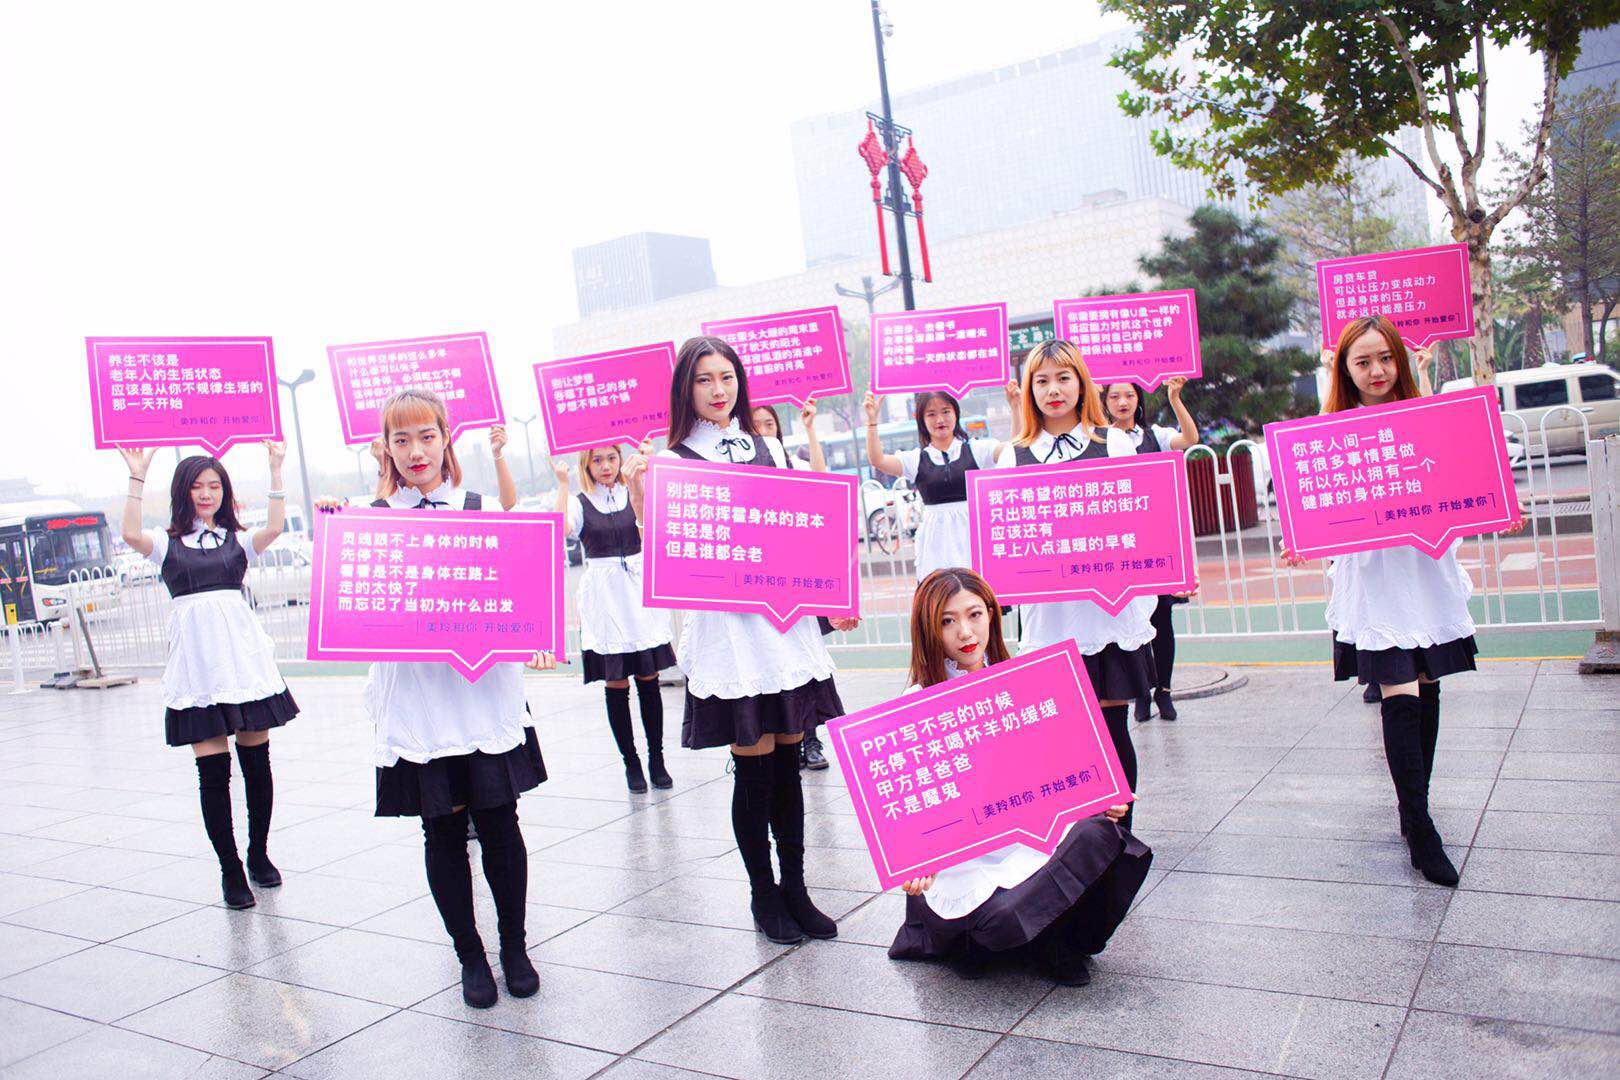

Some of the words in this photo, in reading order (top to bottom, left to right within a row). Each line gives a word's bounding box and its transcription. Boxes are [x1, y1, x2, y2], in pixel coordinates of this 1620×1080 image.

[1334, 270, 1377, 285] 房贷车贷
[1334, 275, 1436, 295] 可以让压力变成动力
[1336, 290, 1414, 308] 但是身体的压力
[1068, 304, 1180, 322] 你需要拥有像U盘一样的
[1336, 300, 1426, 320] 就永远只能是压力
[1069, 316, 1173, 333] 适应能力对抗这个世界
[1393, 318, 1420, 328] 羚和你
[1424, 314, 1456, 324] 开始爱你
[108, 354, 180, 367] 养生不该是
[110, 368, 222, 382] 老年人的生活状态
[111, 381, 264, 396] 应该是从你不规律生活的
[112, 398, 184, 411] 那一天开始
[1292, 428, 1394, 458] 你来人间一趟
[1296, 442, 1416, 475] 有很多事情要做
[1298, 458, 1436, 494] 所以先从拥有一个
[665, 482, 730, 502] 别把年轻
[988, 479, 1132, 506] 我不希望你的朋友圈
[1302, 479, 1422, 511] 健康的身体开始
[666, 502, 825, 529] 当成你挥霍身体的资本
[990, 496, 1150, 524] 只出现午夜两点的街灯
[1385, 504, 1432, 521] 美羚和你
[1438, 496, 1488, 512] 开始爱你
[342, 532, 500, 550] 灵魂跟不上身体的时候
[666, 522, 730, 542] 年轻是你
[992, 522, 1053, 541] 应该还有
[340, 549, 404, 563] 先停下来
[666, 540, 763, 562] 但是谁都会老
[992, 533, 1136, 559] 早上八点温暖的早餐
[338, 564, 498, 582] 看看是不是身体在路上
[1070, 561, 1114, 574] 美羚和你
[1121, 558, 1166, 570] 开始爱你
[338, 581, 417, 596] 走的太快了
[743, 574, 786, 586] 美羚和你
[792, 577, 835, 590] 开始爱你
[337, 597, 514, 614] 而忘记了当初为什么出发
[484, 622, 535, 634] 开始爱你
[861, 690, 1014, 756] PPT写不完的时候
[868, 698, 1058, 779] 先停下来喝杯羊奶缓缓
[876, 753, 973, 799] 甲方是爸爸
[882, 782, 961, 822] 不是魔鬼
[983, 790, 1036, 818] 美羚和你
[1040, 770, 1092, 798] 开始爱你
